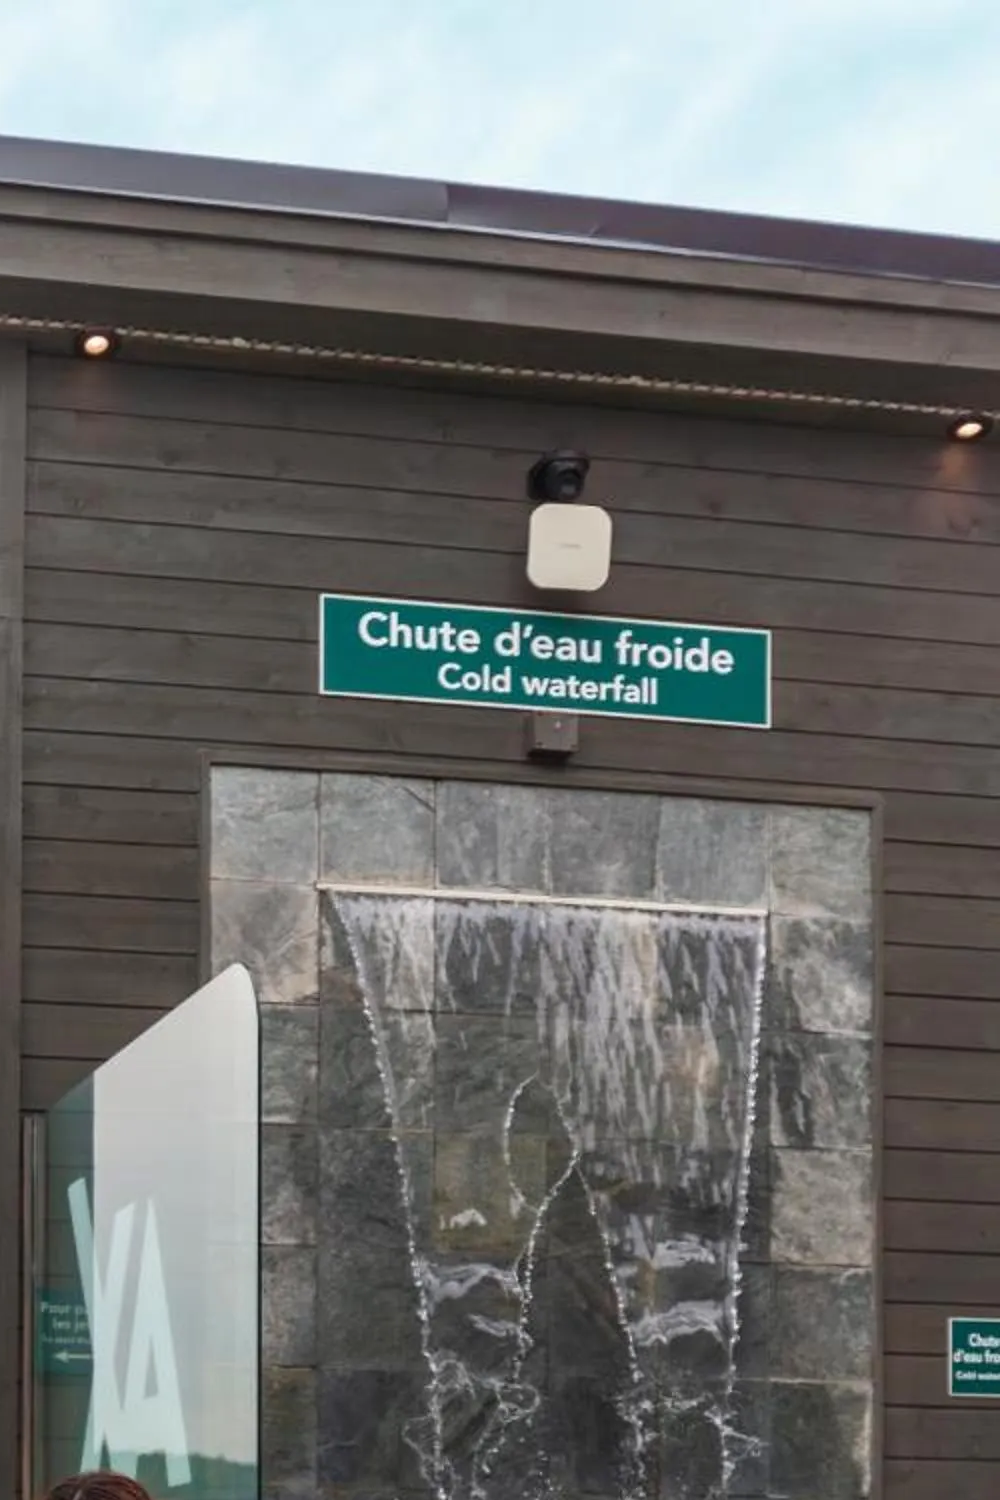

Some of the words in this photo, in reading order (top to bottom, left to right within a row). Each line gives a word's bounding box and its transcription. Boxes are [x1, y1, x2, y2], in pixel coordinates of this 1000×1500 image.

[358, 611, 481, 653] Chute
[494, 621, 602, 663] d'eau
[614, 629, 735, 675] froide
[437, 662, 512, 693] Cold
[521, 674, 658, 705] waterfall
